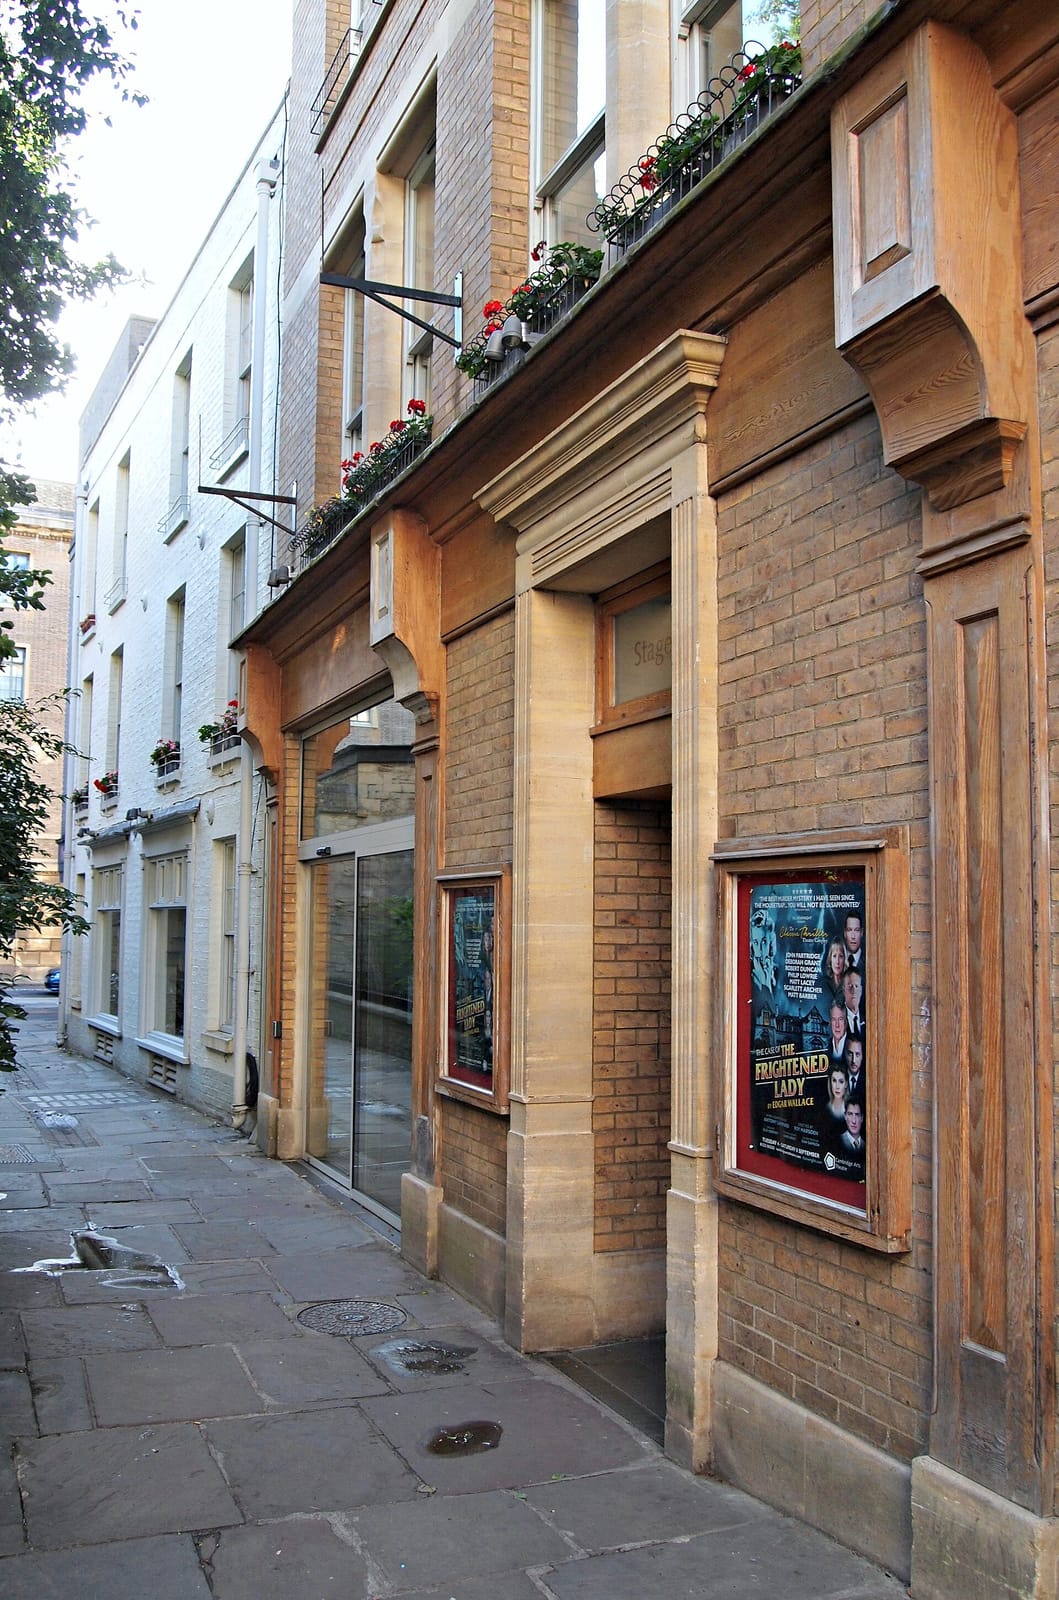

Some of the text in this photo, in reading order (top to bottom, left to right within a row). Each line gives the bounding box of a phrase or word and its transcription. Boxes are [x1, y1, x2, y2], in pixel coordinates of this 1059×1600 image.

[634, 636, 672, 666] Stage
[799, 925, 829, 938] Thriller
[784, 984, 802, 992] SCARLETT
[756, 1048, 765, 1056] THE
[765, 1047, 775, 1055] CASE
[781, 1043, 795, 1056] THE
[755, 1054, 829, 1080] FRIGHTENED
[774, 1077, 805, 1098] LADY
[772, 1100, 787, 1109] EDGAR
[788, 1097, 815, 1107] WALLACE
[762, 1136, 777, 1146] TUESDAY
[799, 1148, 820, 1158] SEPTEMBER
[835, 1157, 853, 1167] Cambridge
